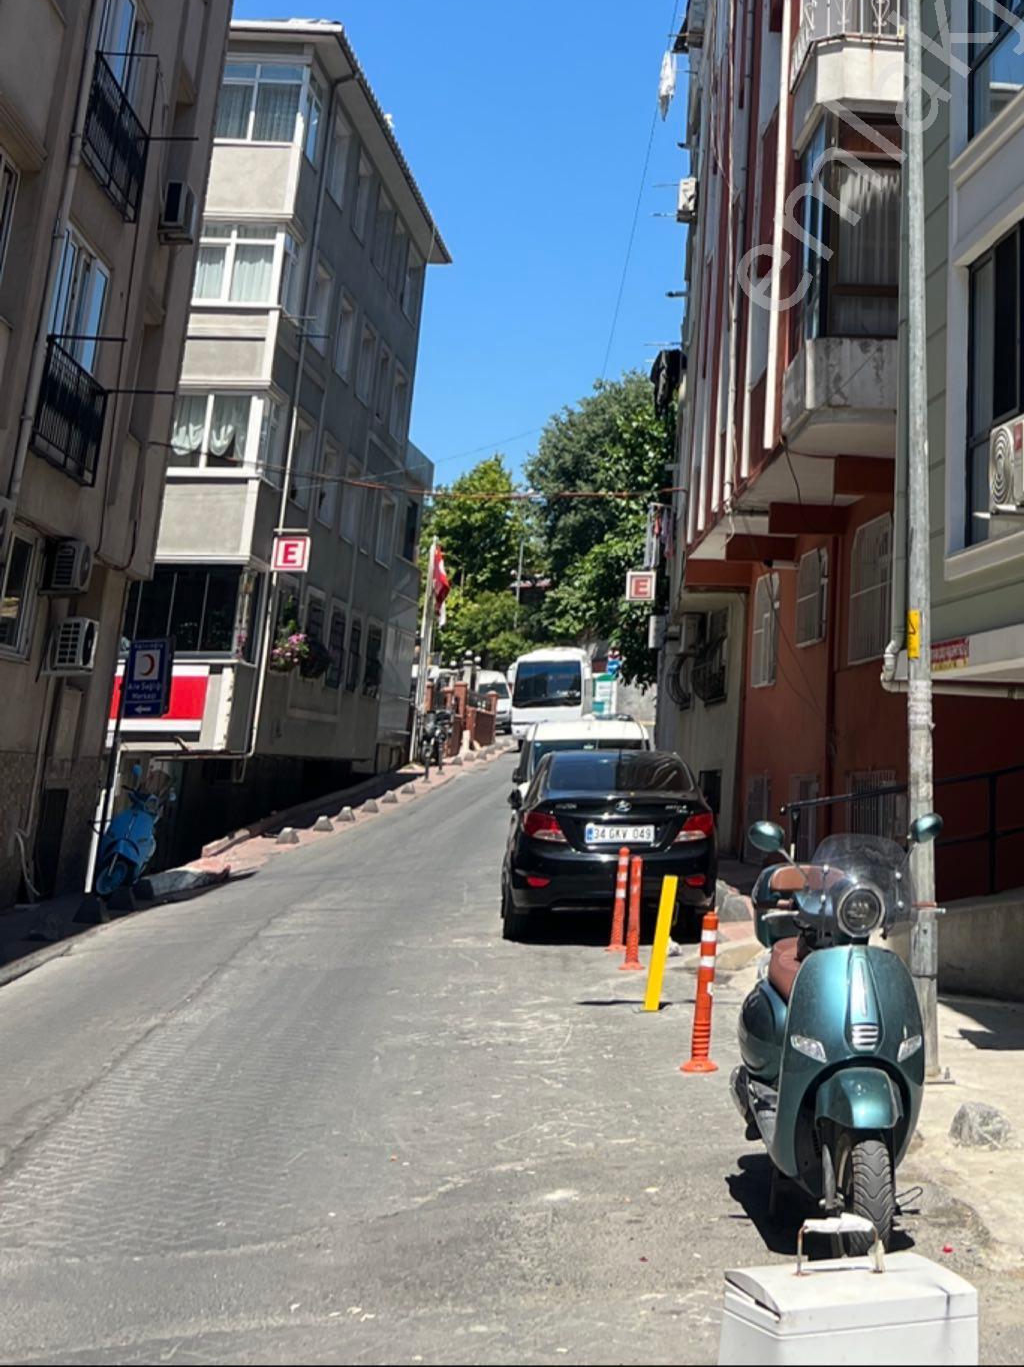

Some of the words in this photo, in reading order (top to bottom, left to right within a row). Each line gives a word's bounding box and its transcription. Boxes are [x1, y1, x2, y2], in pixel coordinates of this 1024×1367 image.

[282, 543, 298, 564] E
[634, 579, 648, 596] E
[594, 828, 606, 838] 34
